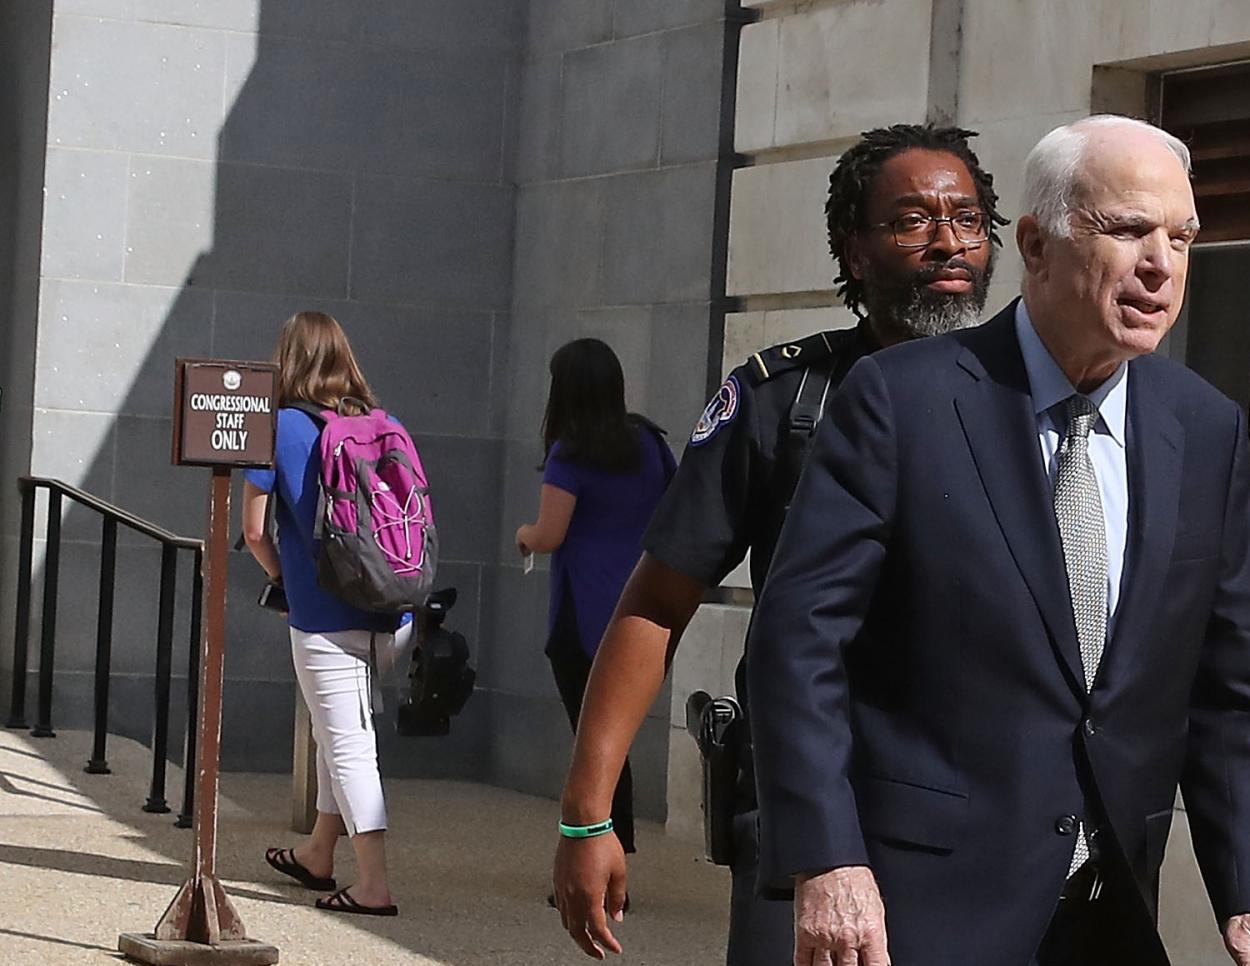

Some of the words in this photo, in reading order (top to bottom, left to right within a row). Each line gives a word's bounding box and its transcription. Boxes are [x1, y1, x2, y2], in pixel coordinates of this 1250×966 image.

[191, 394, 270, 412] CONGRESSIONAL
[216, 413, 244, 428] STAFF
[211, 430, 247, 450] ONLY
